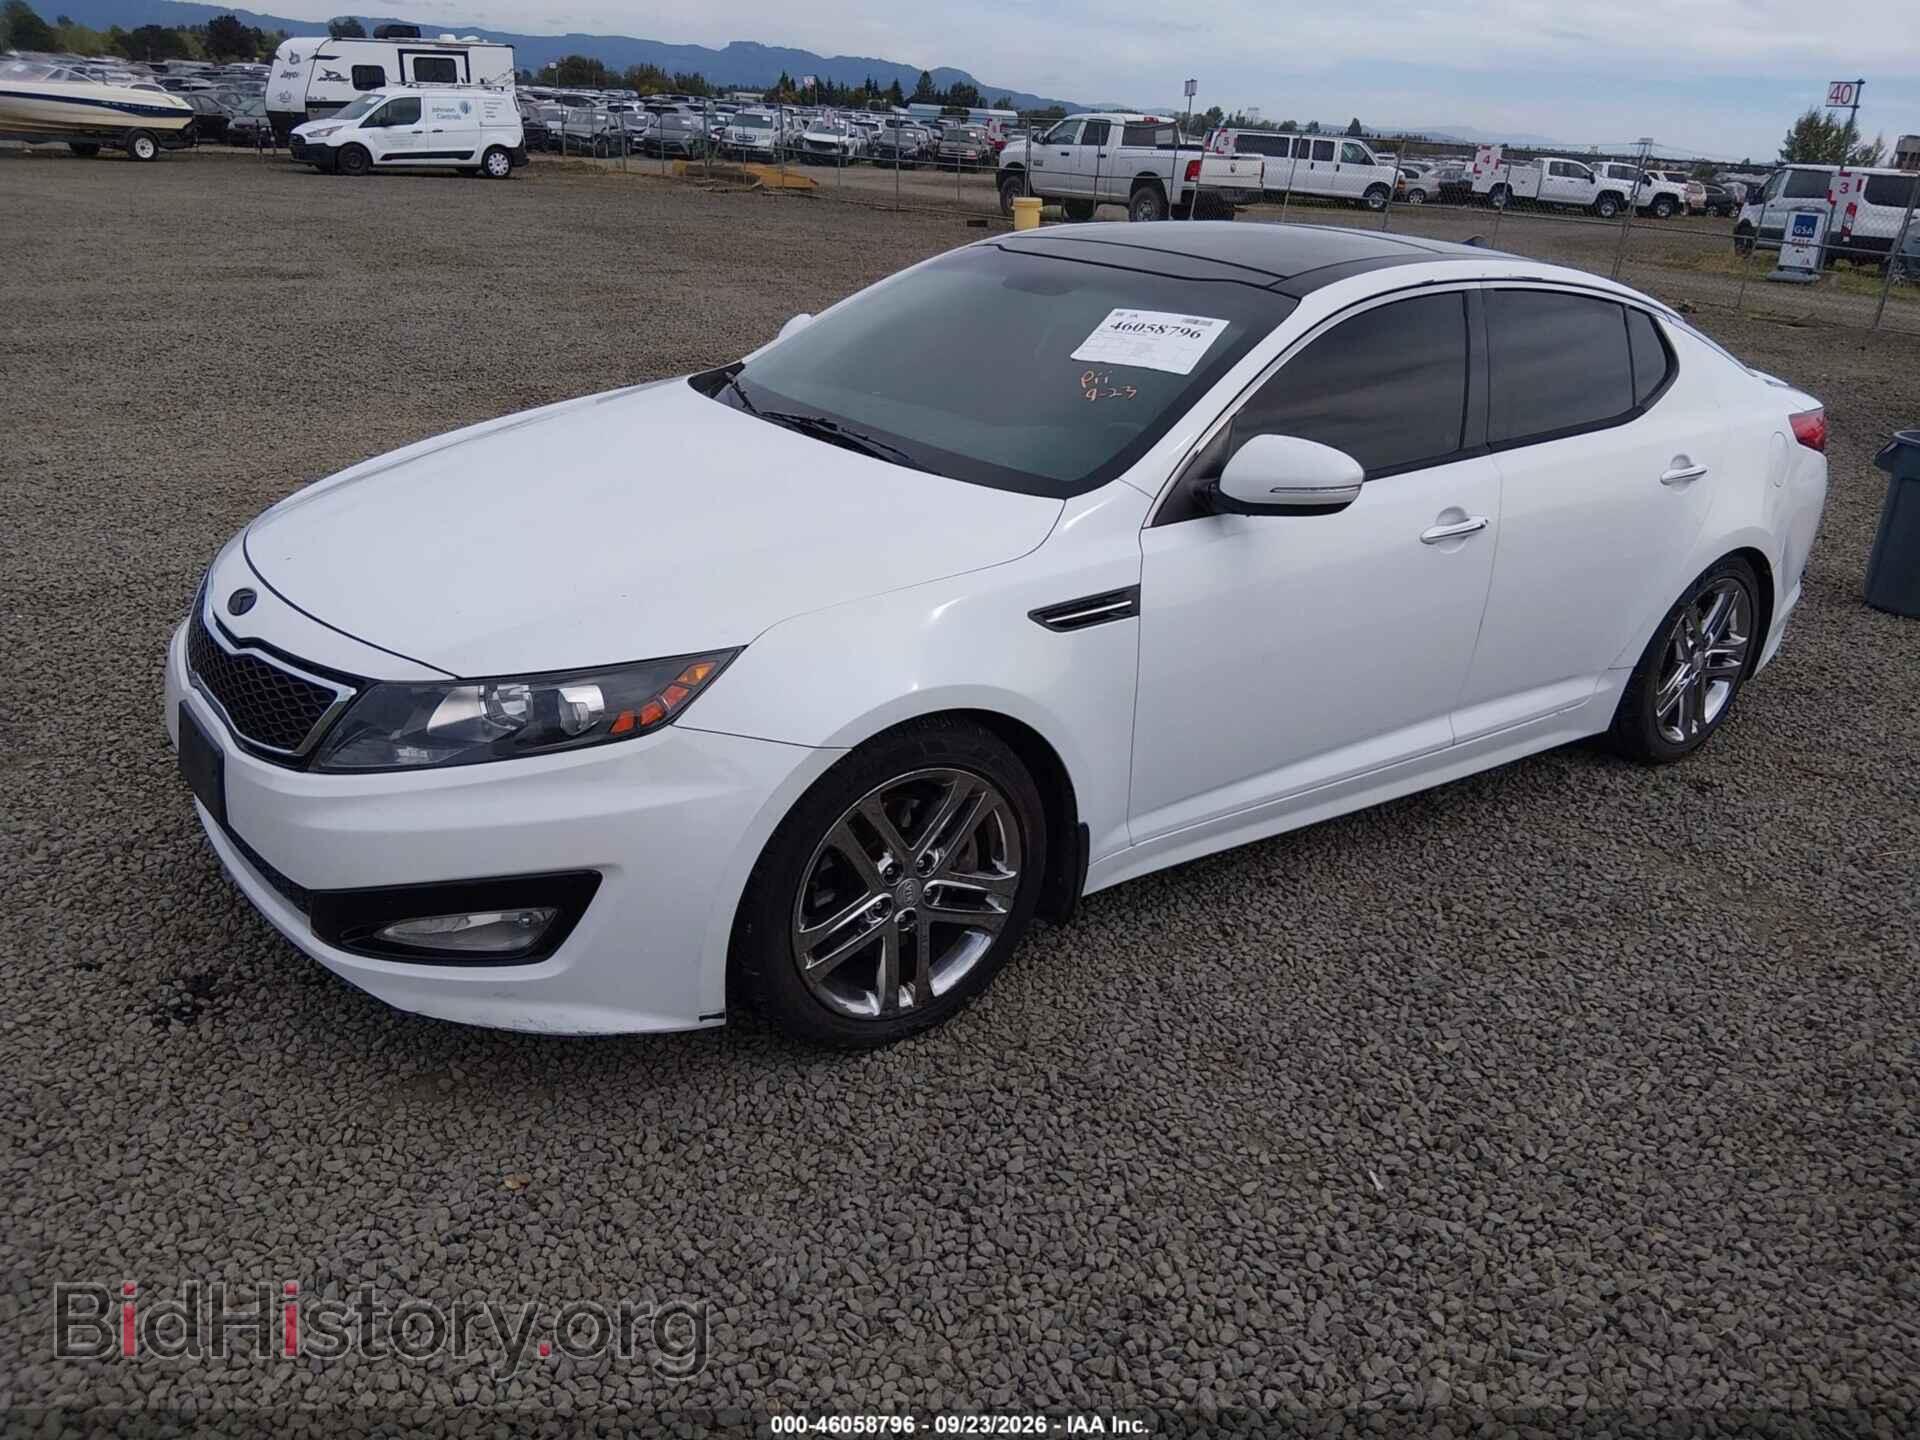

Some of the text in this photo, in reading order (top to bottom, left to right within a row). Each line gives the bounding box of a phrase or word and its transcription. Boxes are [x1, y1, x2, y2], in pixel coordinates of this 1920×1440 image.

[1829, 84, 1853, 105] 40
[1840, 182, 1849, 194] 3
[1794, 225, 1813, 235] GSA
[1110, 320, 1201, 340] 46058796
